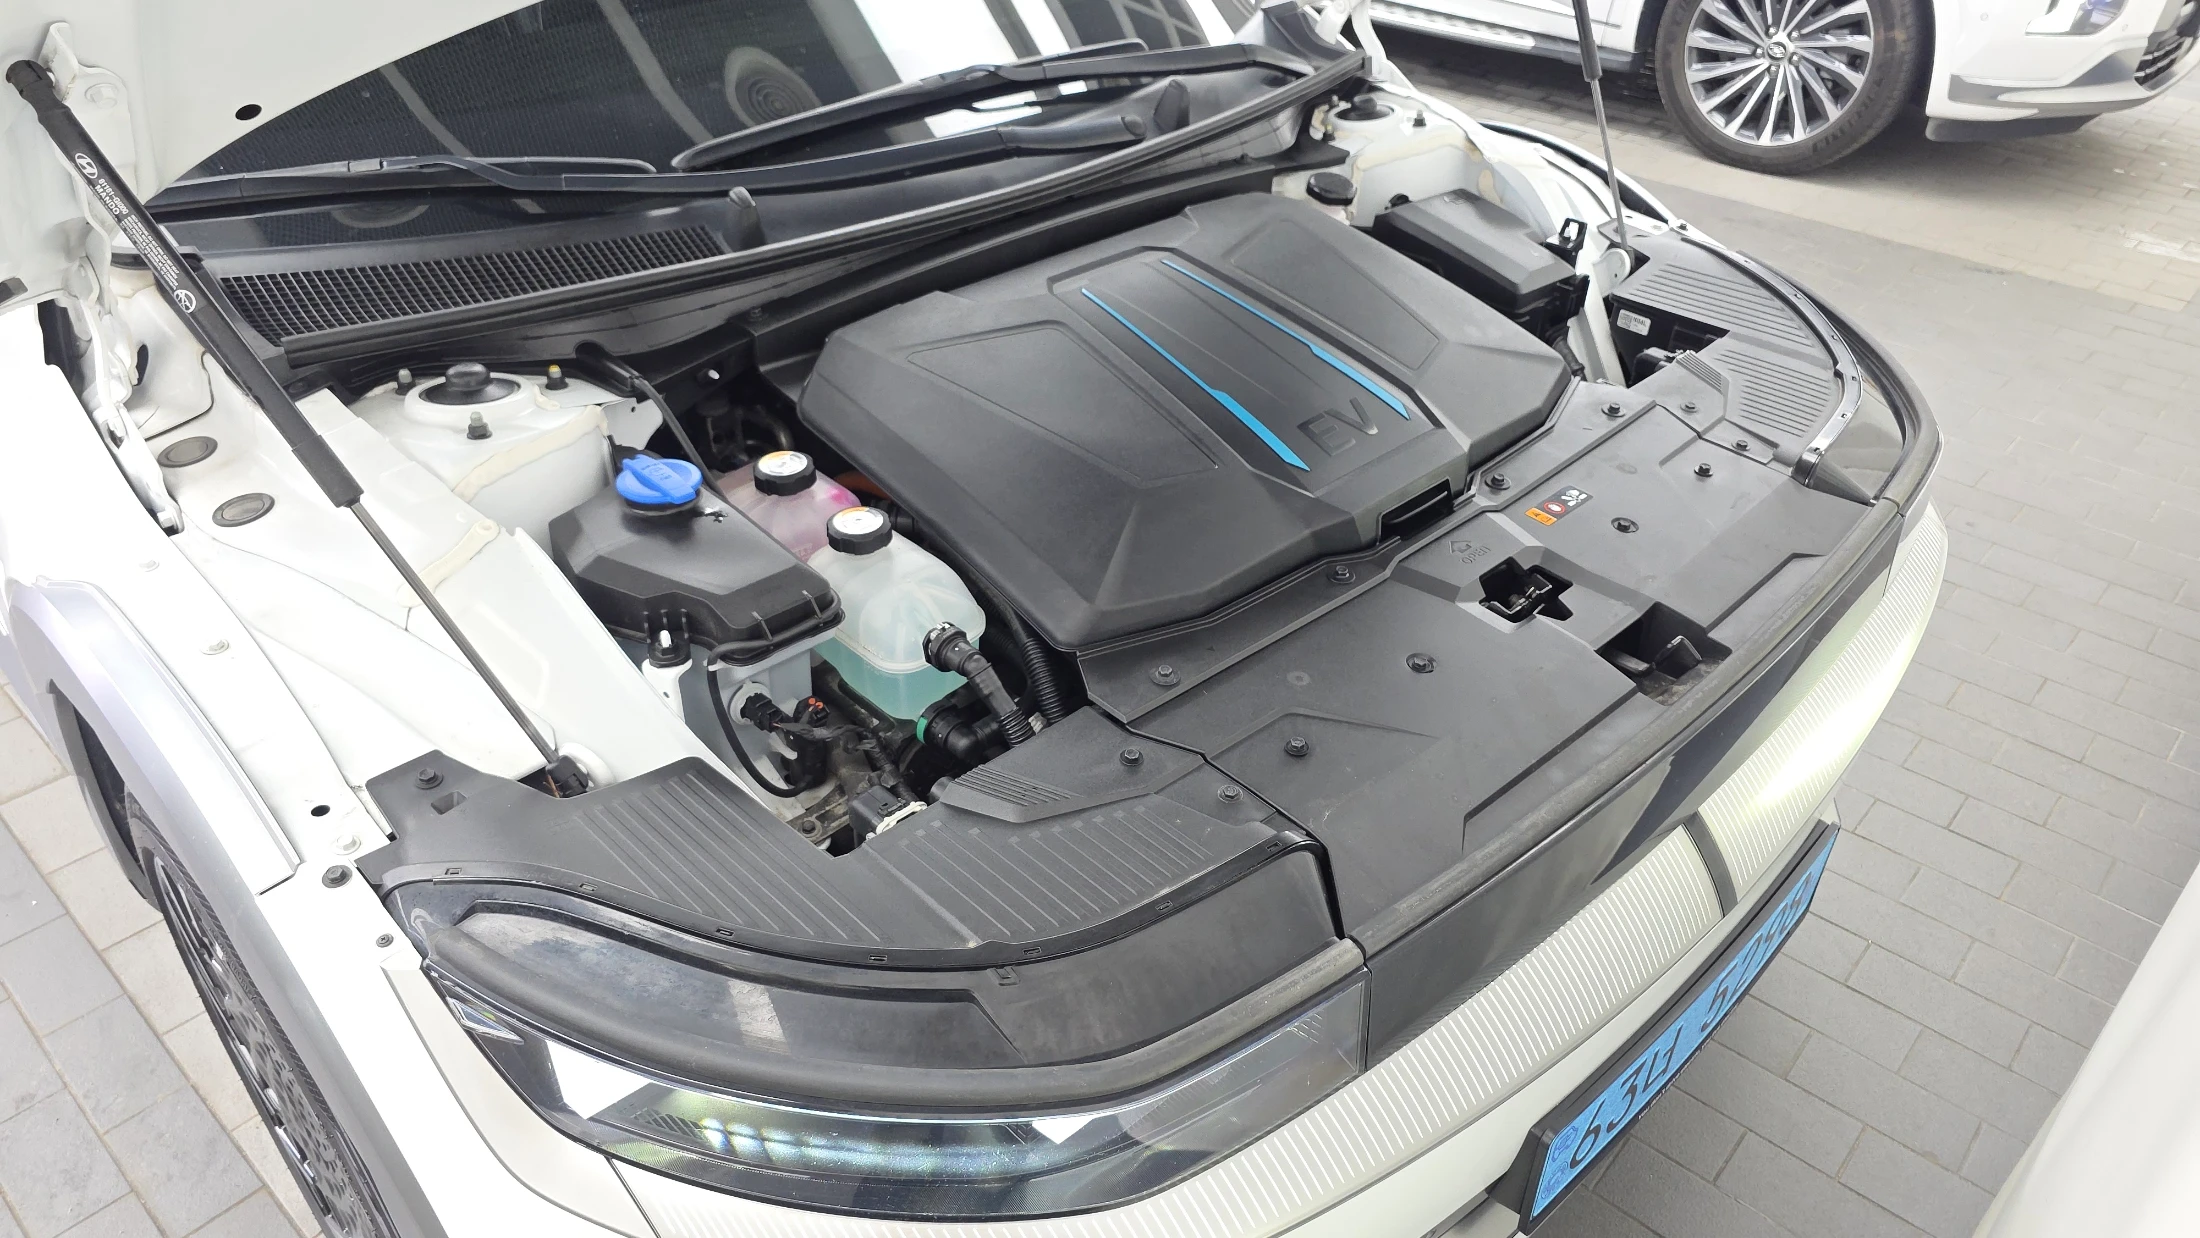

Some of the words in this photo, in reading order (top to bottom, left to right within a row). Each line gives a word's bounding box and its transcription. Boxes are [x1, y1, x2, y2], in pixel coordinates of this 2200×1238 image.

[94, 185, 120, 216] MANDO
[1297, 397, 1379, 457] EV
[1569, 1022, 1684, 1170] 63너
[1700, 871, 1812, 1033] 5298
